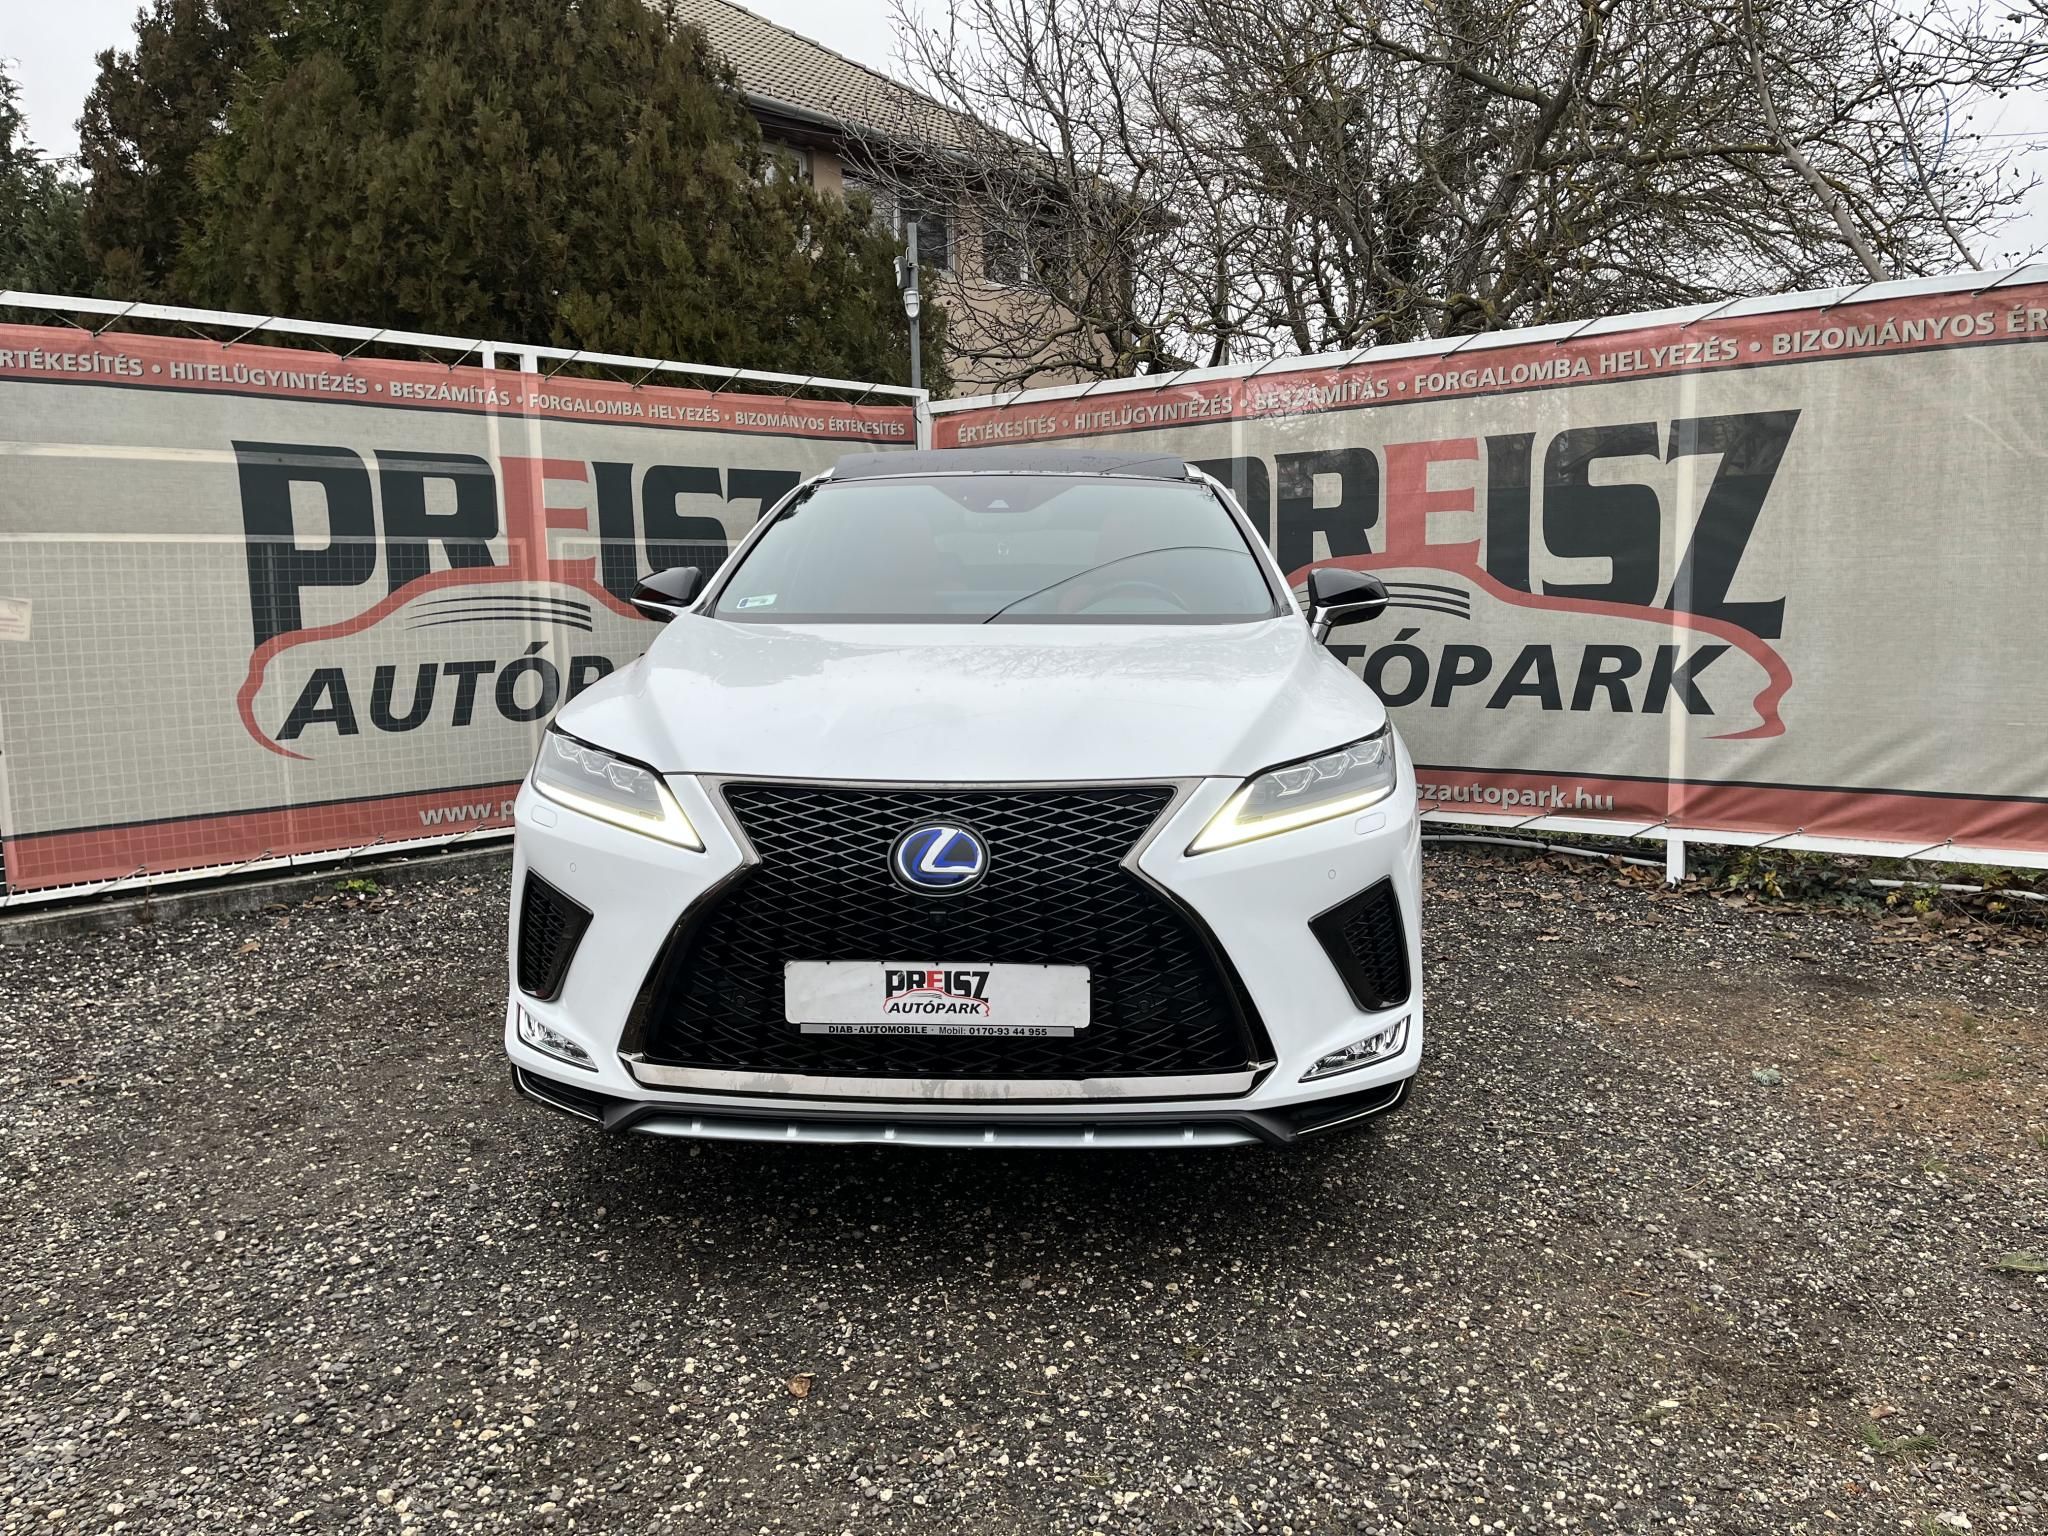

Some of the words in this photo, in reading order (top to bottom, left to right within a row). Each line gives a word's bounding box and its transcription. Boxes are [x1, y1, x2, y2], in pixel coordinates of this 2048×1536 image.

[170, 361, 368, 394] HITELÜGYINTÉZÉS
[390, 380, 510, 406] BESZÁMÍTÁS
[529, 393, 644, 418] FORGALOMBA
[648, 403, 720, 423] HELYEZÉS
[735, 411, 825, 432] BIZOMÁNYOS
[828, 416, 905, 436] ÉRTÉKESÍTÉS
[957, 415, 1057, 443] ÉRTÉKESÍTÉS
[1074, 394, 1233, 431] HITELÜGYINTÉZÉS
[1255, 375, 1390, 411] BESZÁMÍTÁS
[1414, 357, 1591, 393] FORGALOMBA
[1600, 336, 1739, 374] HELYEZÉS
[1772, 312, 1995, 355] BIZOMÁNYOS
[275, 641, 645, 741] AUTÓP
[884, 969, 990, 1003] PREISZ
[887, 999, 982, 1015] AUTÓPARK
[828, 1025, 928, 1034] DIAB-AUTOMOBILE
[938, 1026, 966, 1035] Mobil:
[968, 1027, 1010, 1036] 0170-93
[1012, 1027, 1025, 1036] 44
[1028, 1027, 1048, 1036] 955
